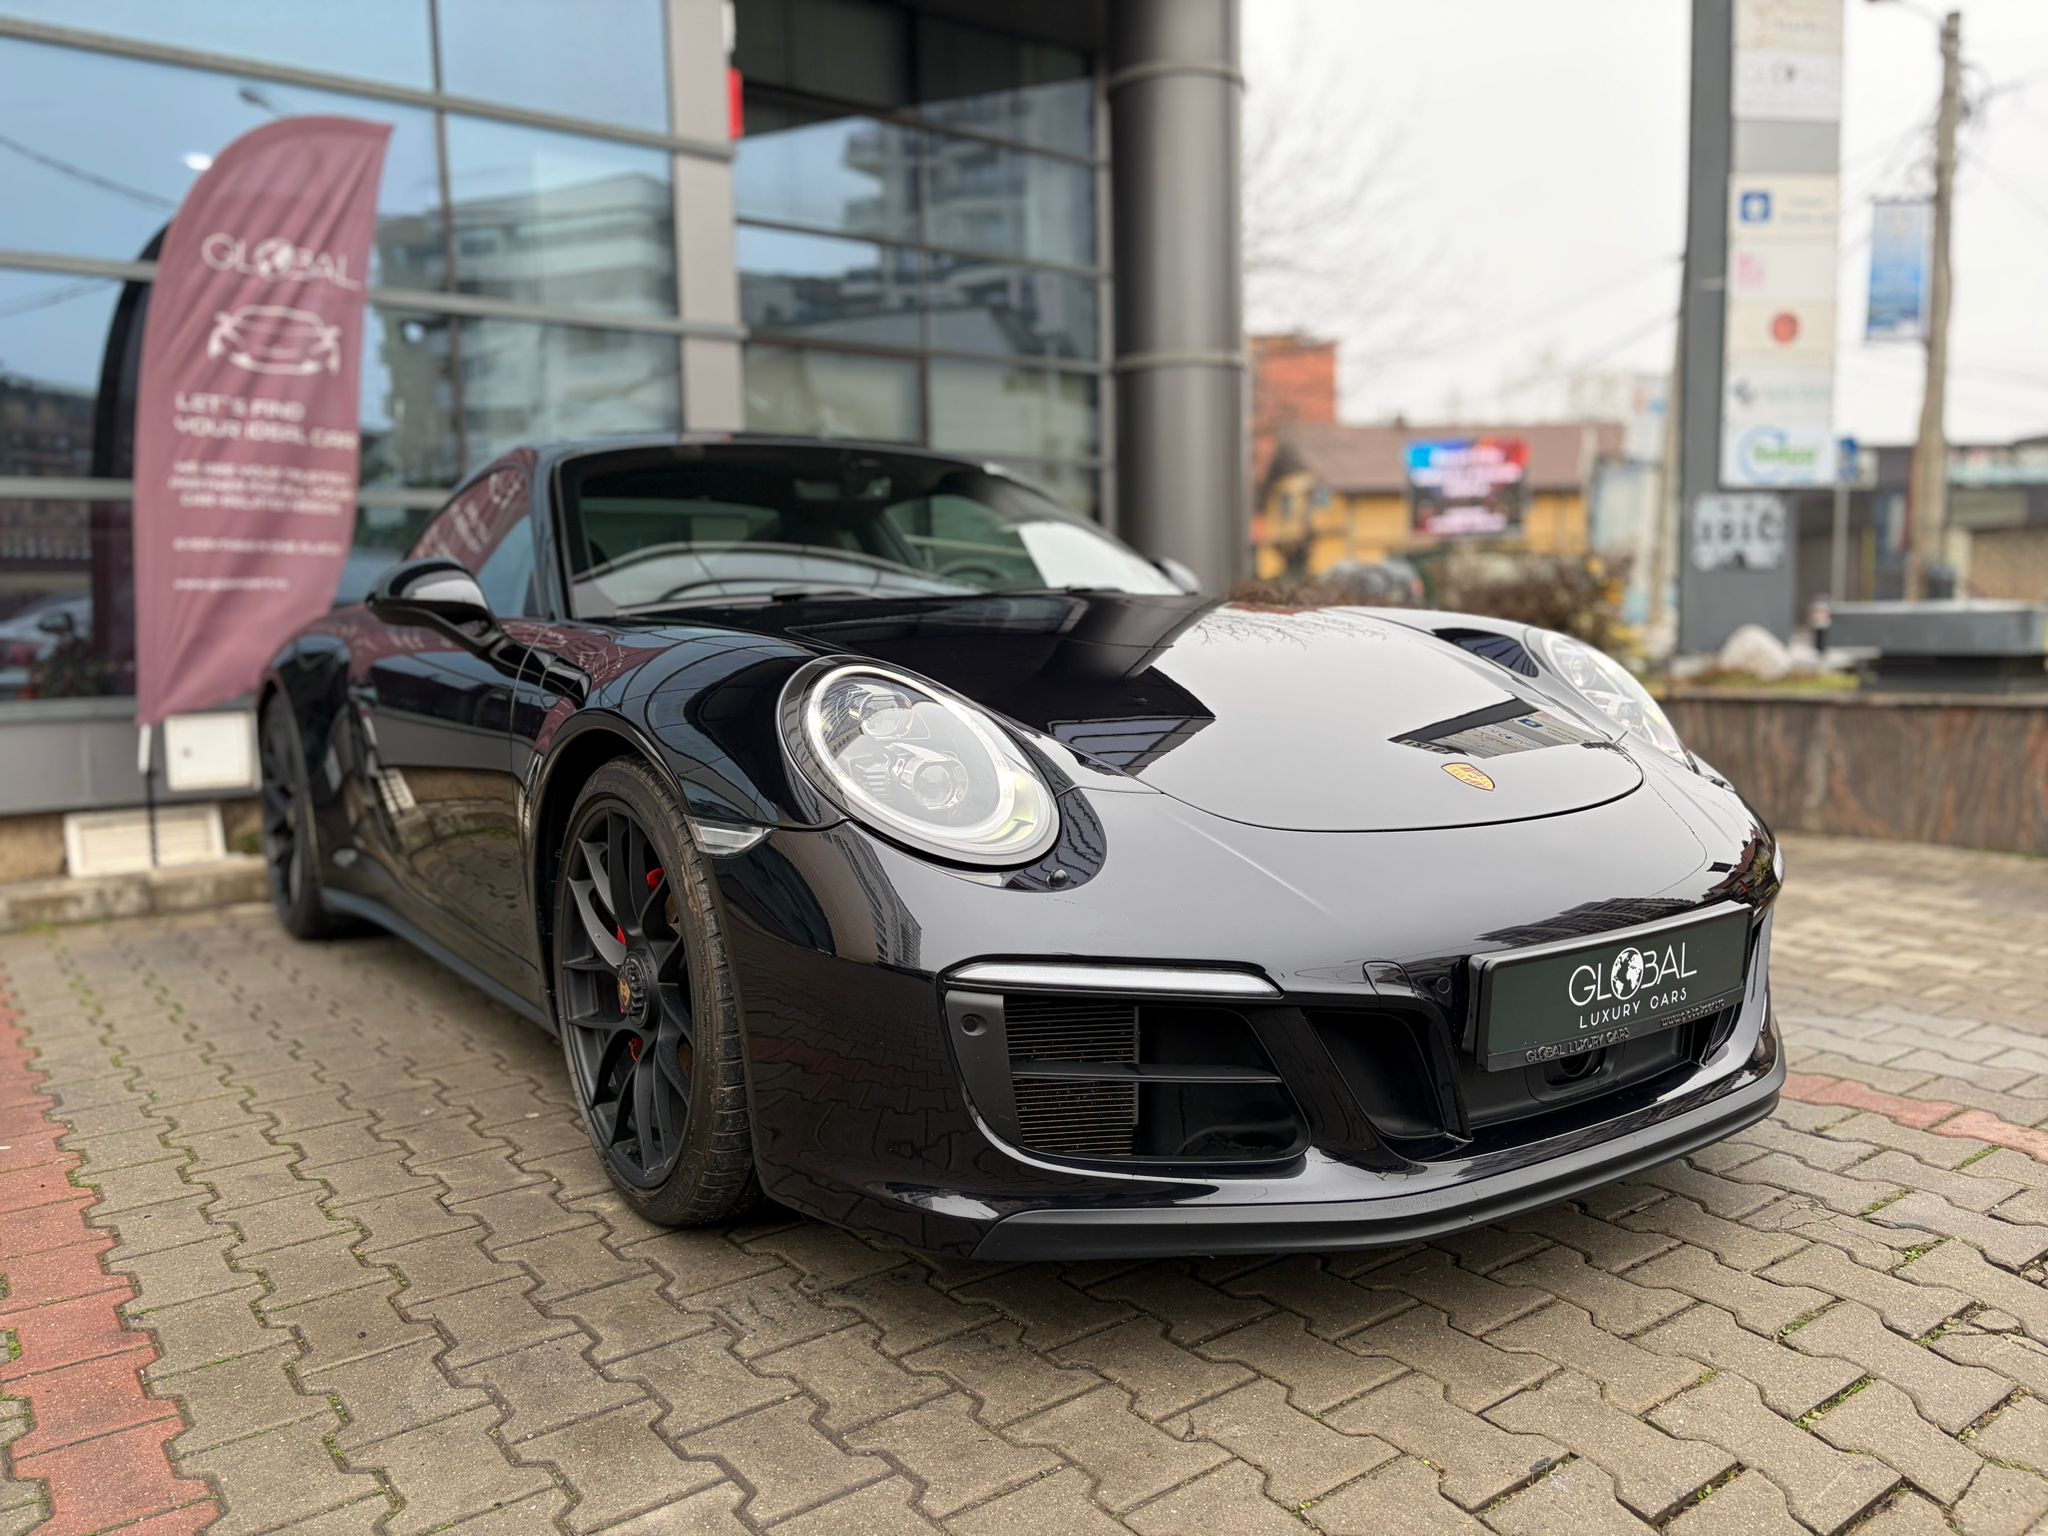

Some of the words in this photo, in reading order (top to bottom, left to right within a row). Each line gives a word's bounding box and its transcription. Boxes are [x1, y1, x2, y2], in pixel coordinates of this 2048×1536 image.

[200, 232, 361, 292] GLOBAL
[1568, 942, 1698, 1007] GLOBAL
[1579, 1000, 1642, 1029] LUXURY
[1650, 988, 1688, 1008] CARS
[1525, 1045, 1566, 1063] GLOBAL
[1569, 1035, 1604, 1053] LUXURY
[1606, 1025, 1631, 1044] CARS
